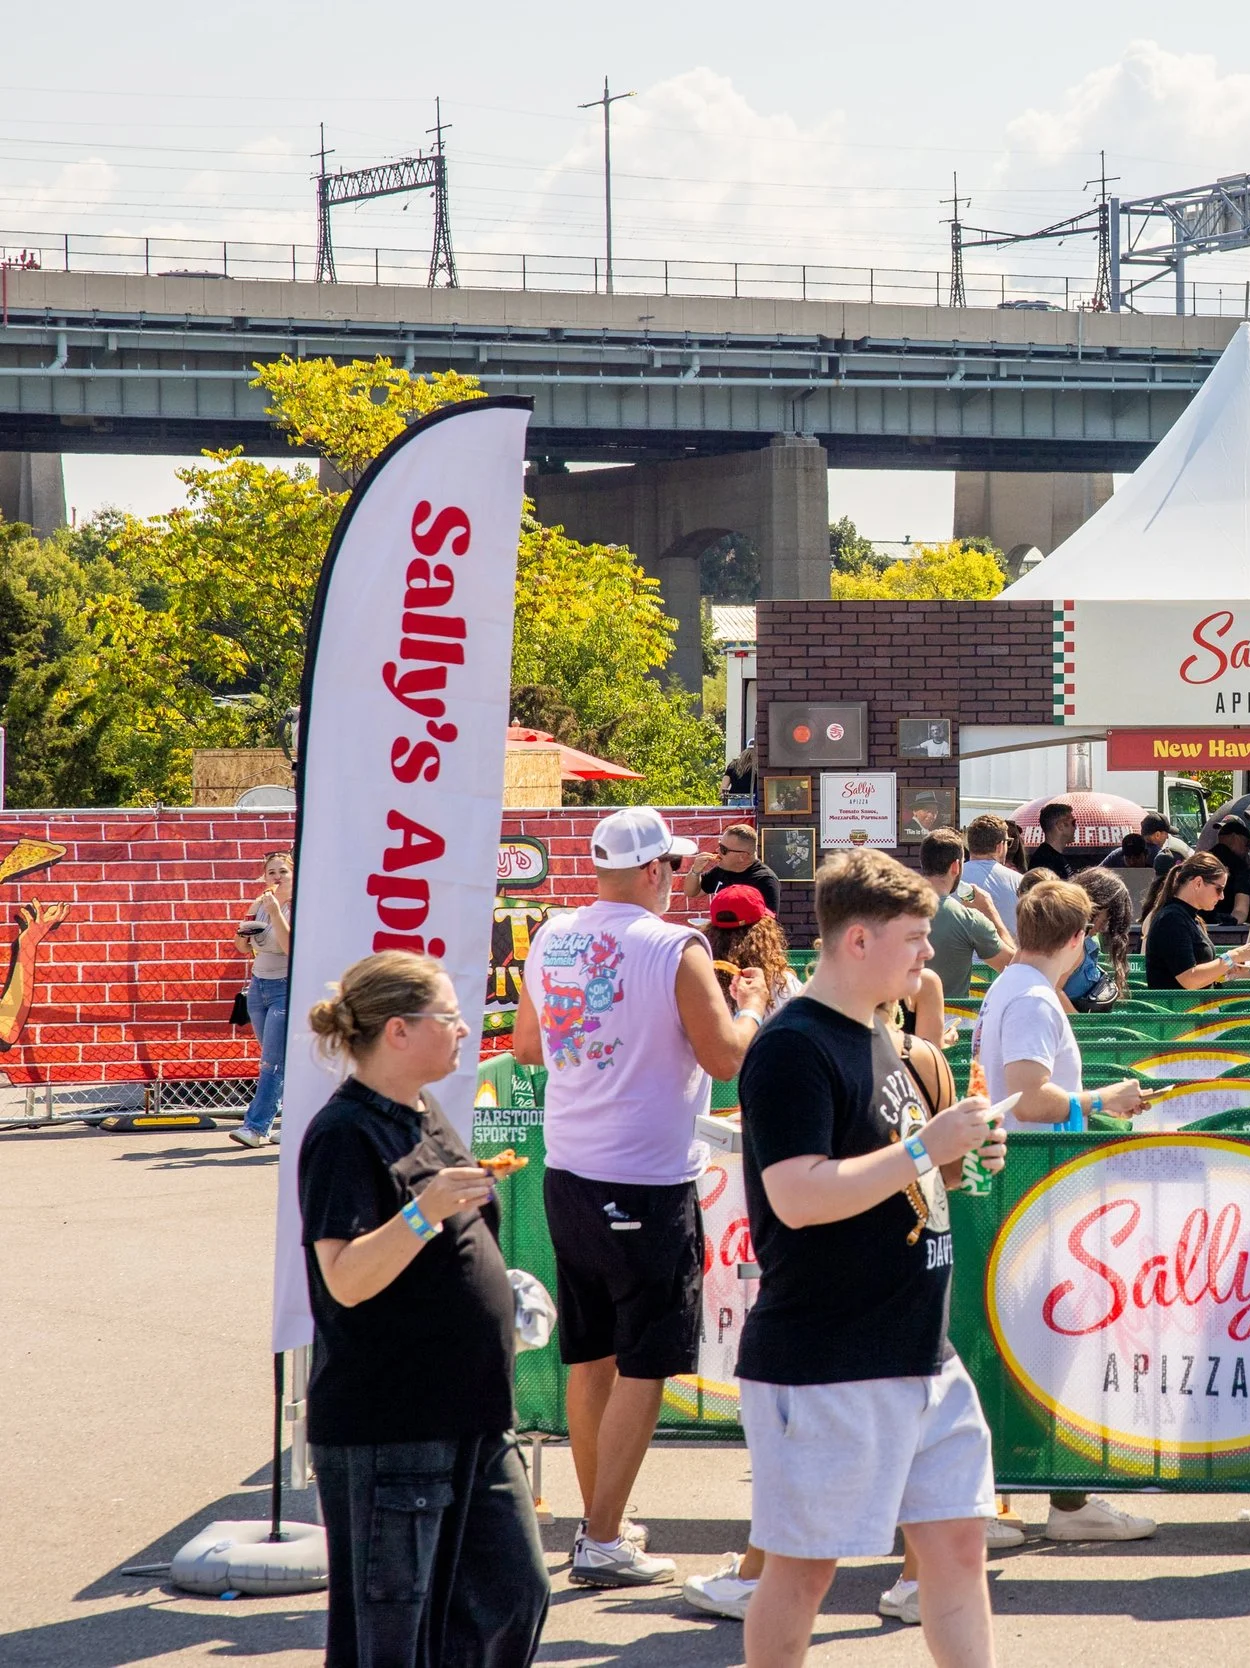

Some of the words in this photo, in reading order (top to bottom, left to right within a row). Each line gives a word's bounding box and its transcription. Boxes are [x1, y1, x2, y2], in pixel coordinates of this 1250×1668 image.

[382, 499, 472, 783] Sally's
[1152, 739, 1203, 759] New
[841, 780, 876, 799] Sally's
[473, 1110, 544, 1126] BARSTOOL
[474, 1126, 527, 1142] SPORTS
[1103, 1354, 1249, 1398] APIZZA
